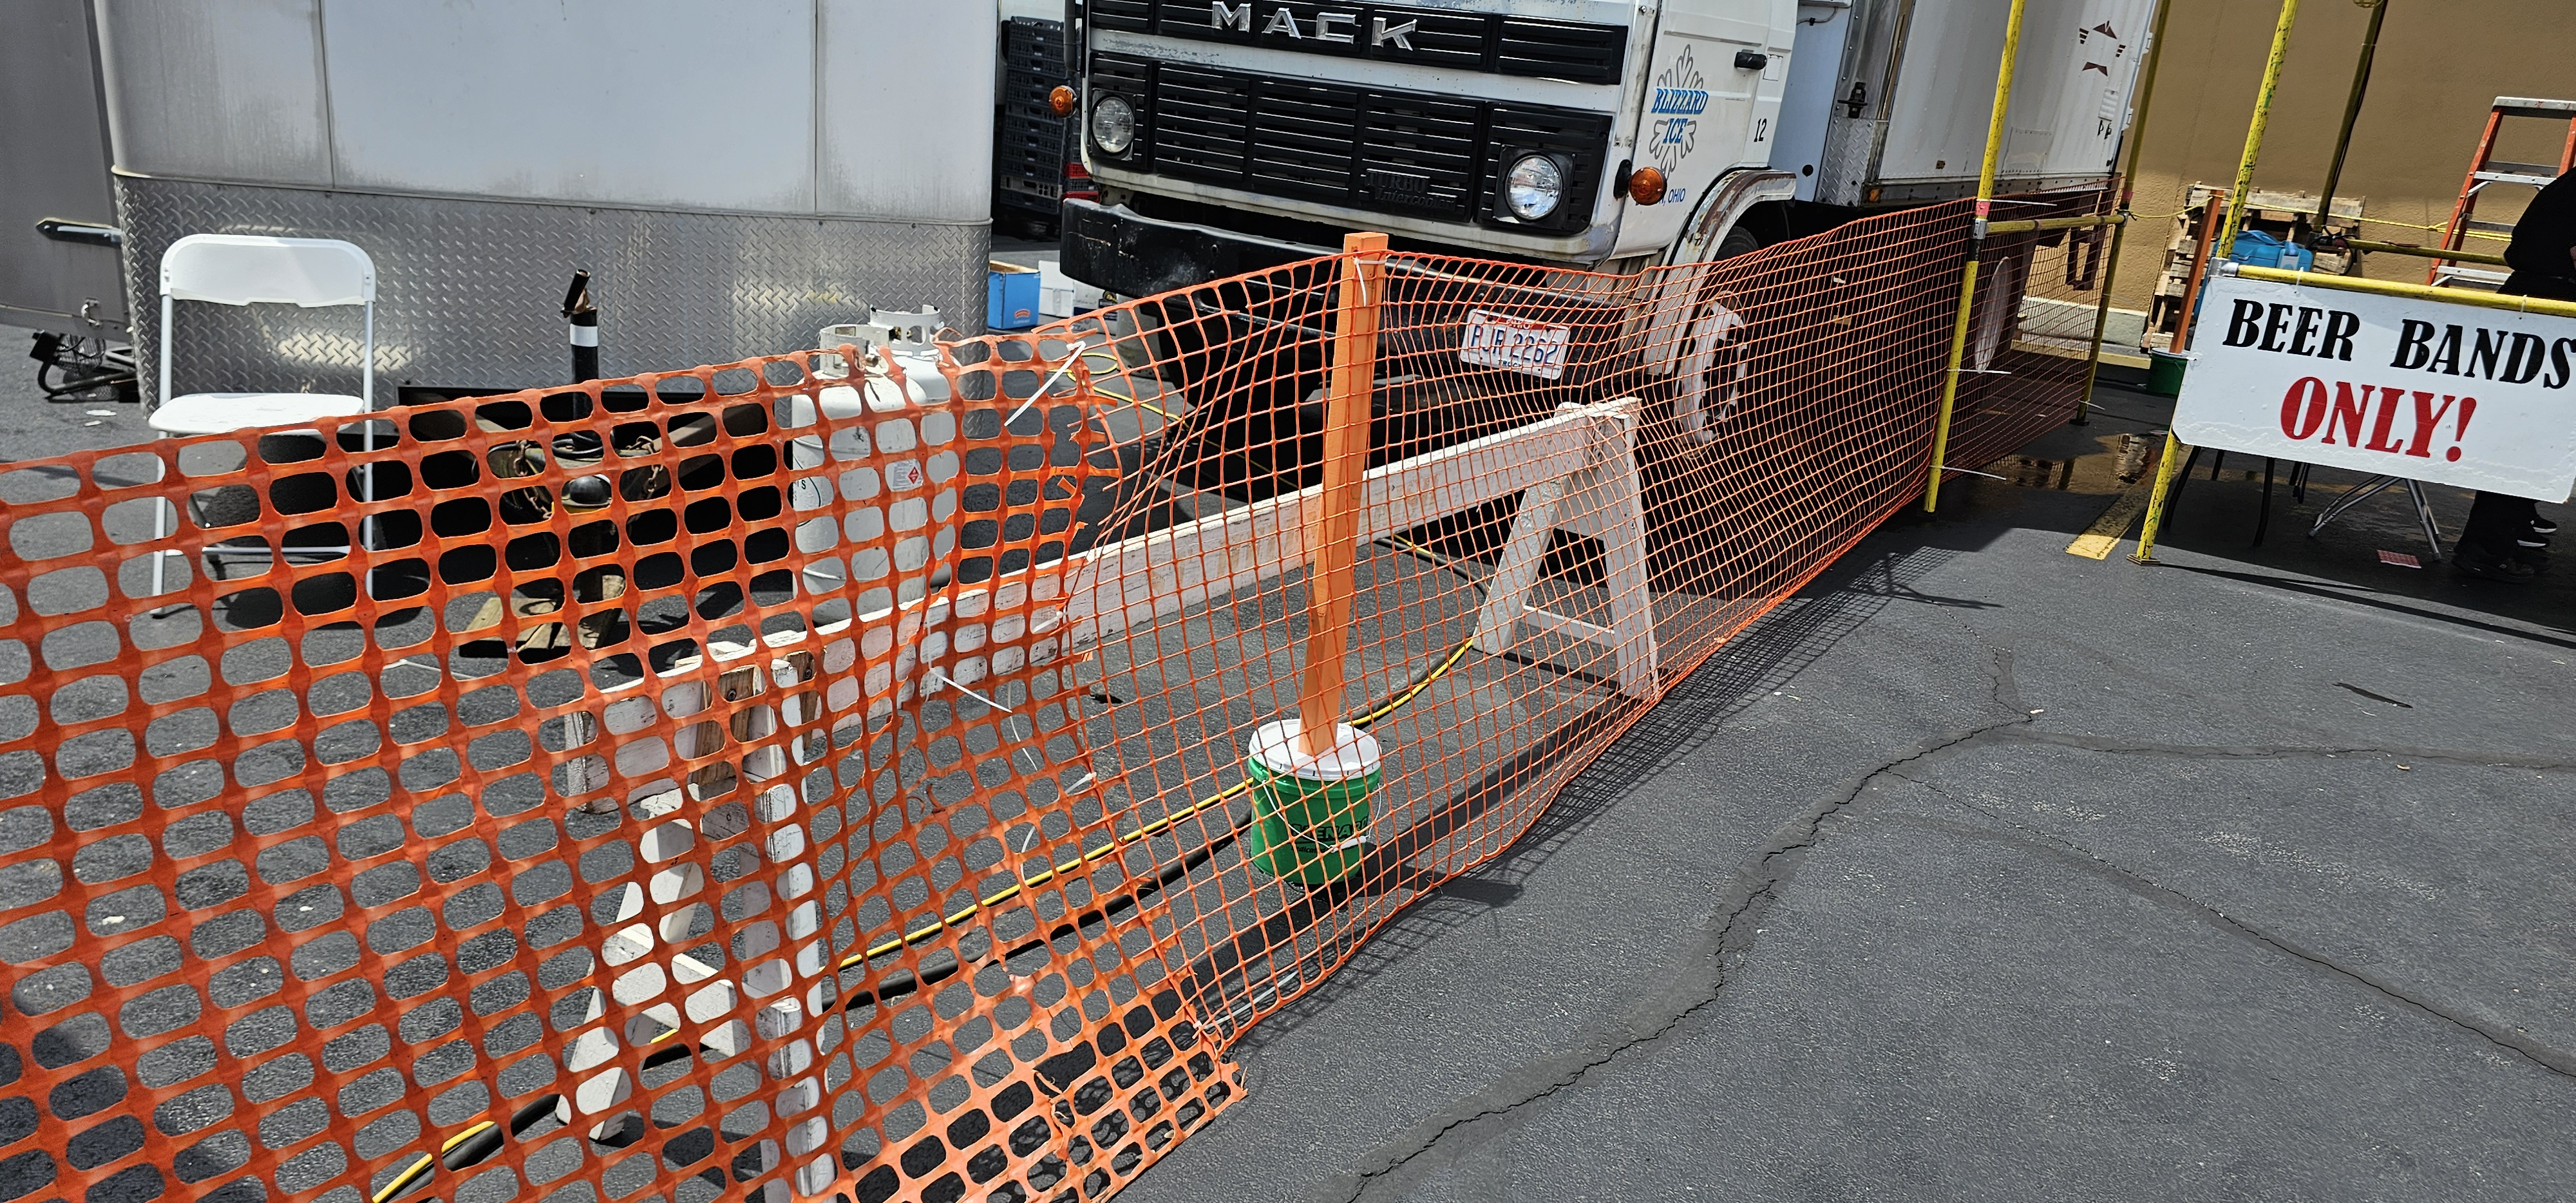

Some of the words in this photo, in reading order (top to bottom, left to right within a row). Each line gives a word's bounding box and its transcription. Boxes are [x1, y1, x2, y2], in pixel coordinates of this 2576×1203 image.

[1211, 1, 1417, 51] MACK
[1651, 88, 1709, 115] BLIZZARD
[1662, 118, 1688, 144] ICE
[1754, 118, 1767, 142] 12
[1365, 171, 1428, 194] TURBO
[1668, 188, 1686, 204] OHIO
[2222, 298, 2360, 362] BEER
[2391, 319, 2576, 389] BANDS
[2280, 376, 2477, 462] ONLY!
